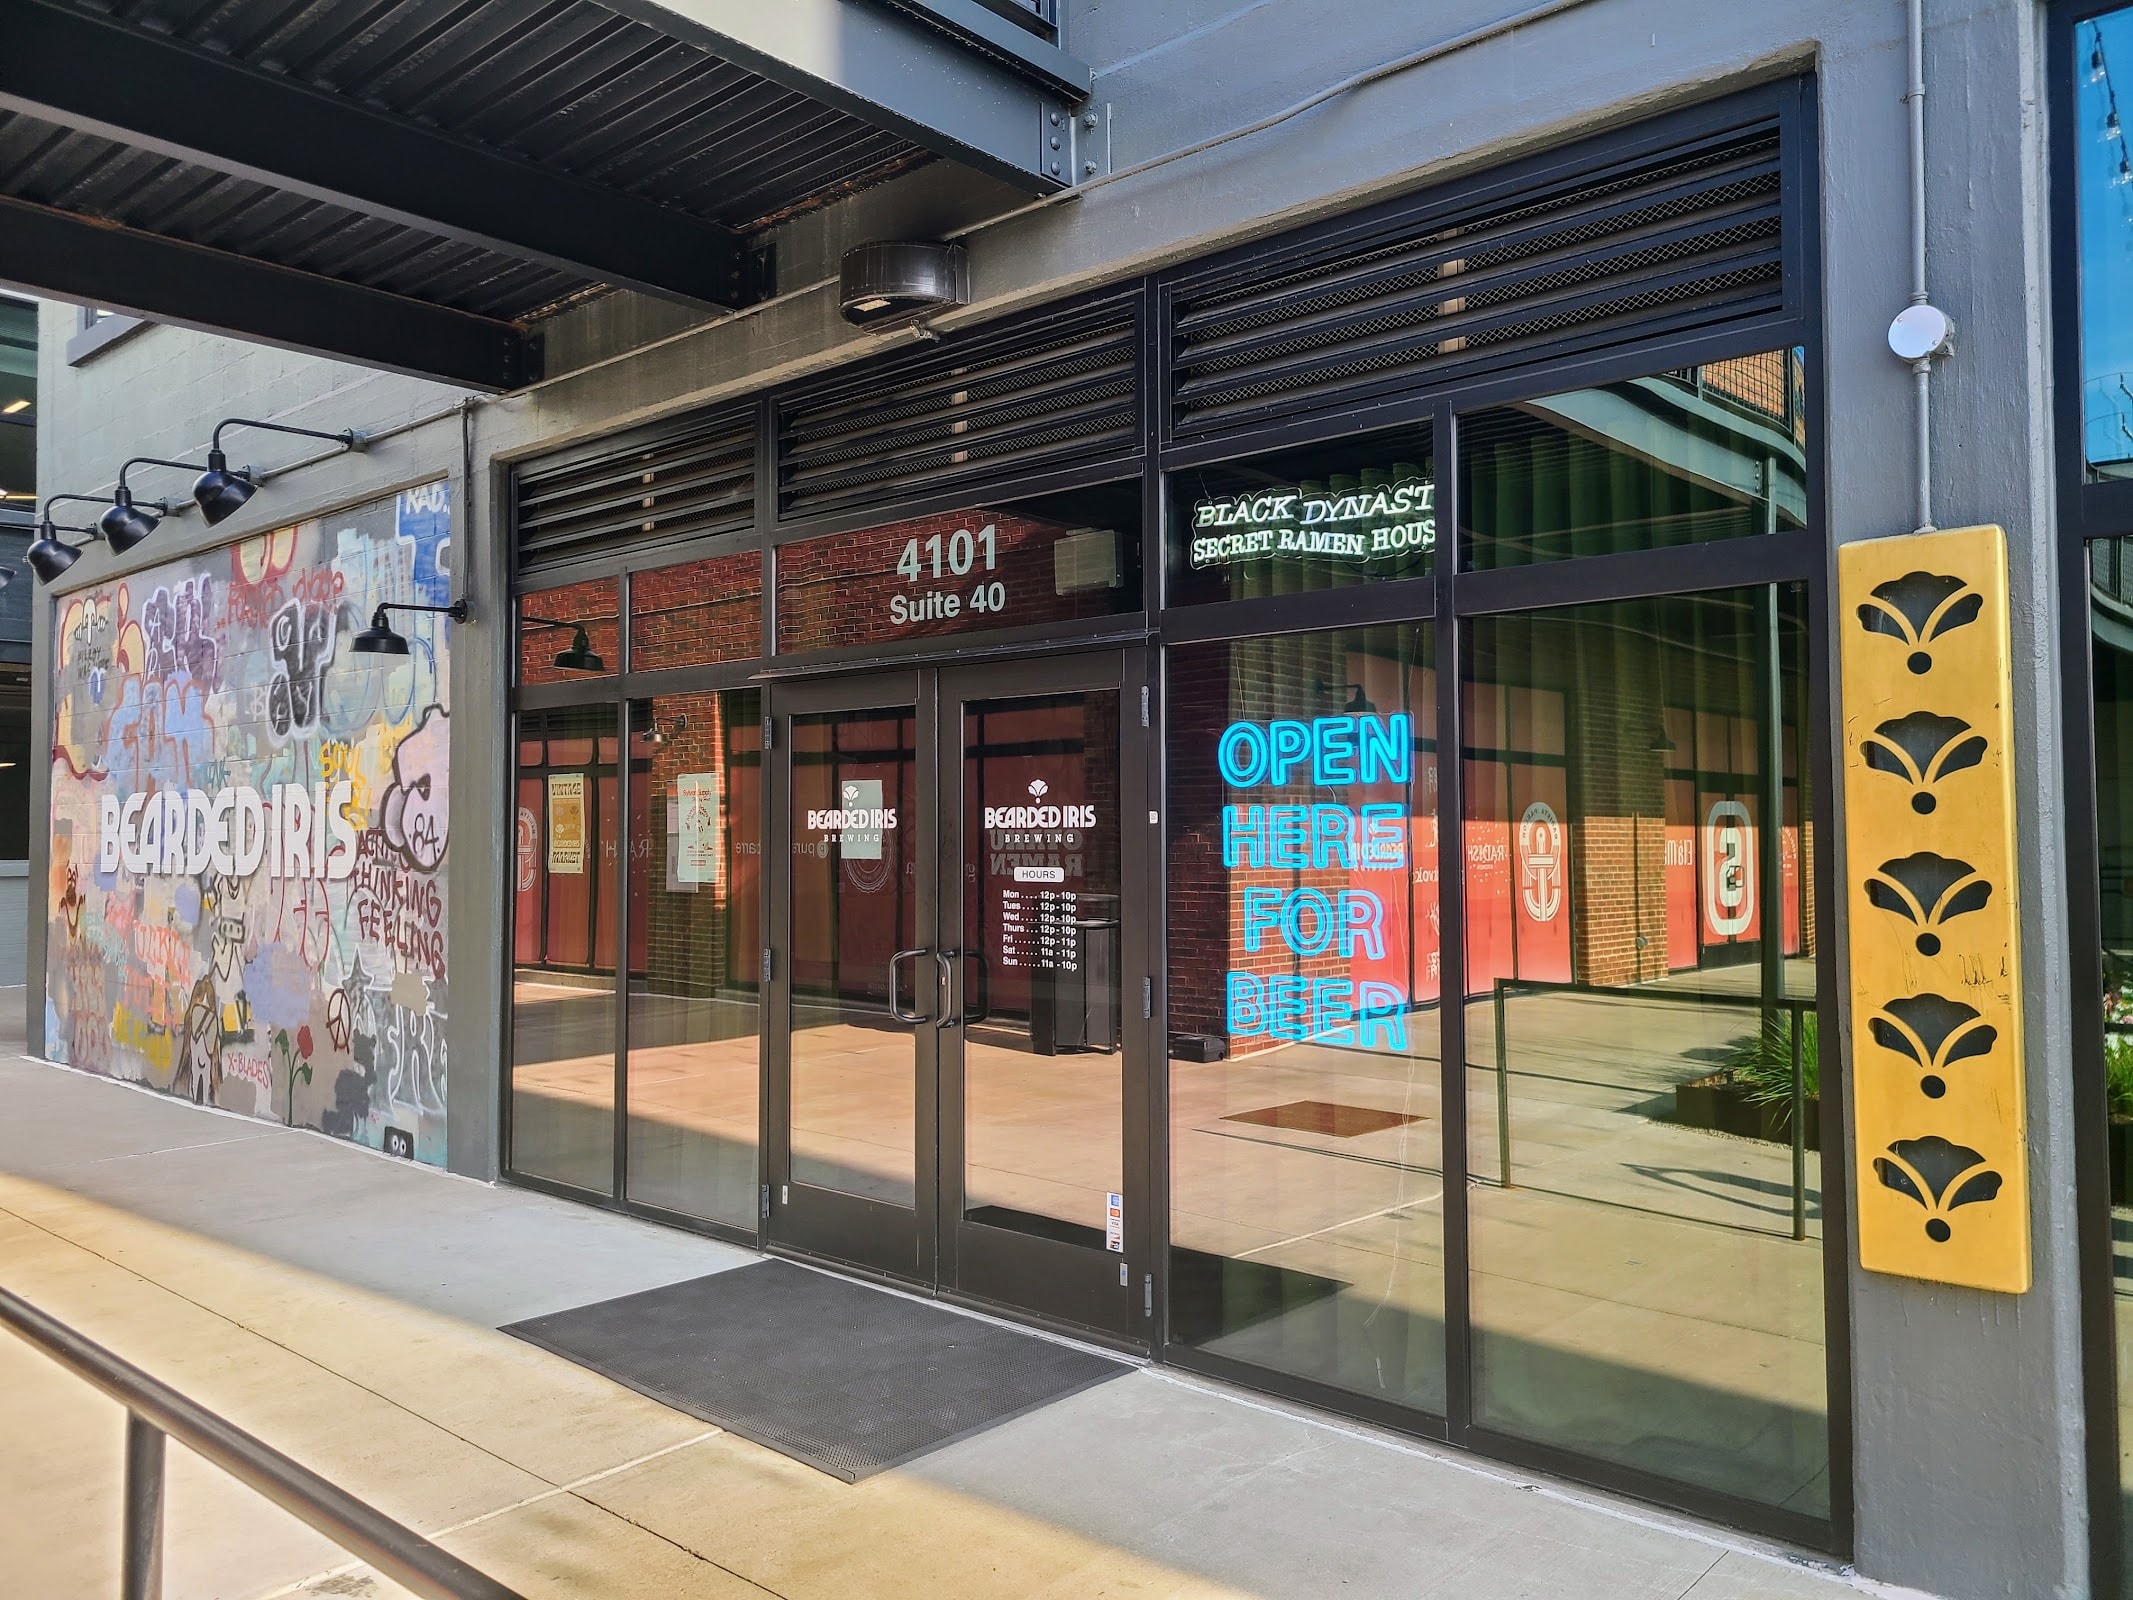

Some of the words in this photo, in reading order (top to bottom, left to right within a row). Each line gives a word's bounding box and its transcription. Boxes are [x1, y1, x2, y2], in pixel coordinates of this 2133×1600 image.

[1196, 495, 1297, 527] BLACK
[897, 524, 995, 582] 4101
[1193, 530, 1273, 562] SECRET
[1277, 528, 1366, 554] RAMEN
[890, 591, 960, 625] Suite
[970, 581, 1006, 613] 40
[1217, 712, 1411, 788] OPEN
[100, 786, 265, 877] BEARDED
[271, 780, 357, 880] IRIS
[807, 807, 870, 830] BEARDED
[870, 808, 898, 829] IRIS
[823, 833, 880, 843] BREWING
[984, 806, 1061, 829] BEARDED
[1062, 804, 1097, 828] IRIS
[1004, 833, 1075, 844] BREWING
[1222, 803, 1405, 869] HERE
[353, 862, 442, 928] THINKING
[1022, 870, 1056, 879] HOURS
[358, 898, 446, 979] FEELING
[1243, 886, 1386, 961] FOR
[1226, 971, 1408, 1051] BEER
[227, 1052, 270, 1090] X-BLADES
